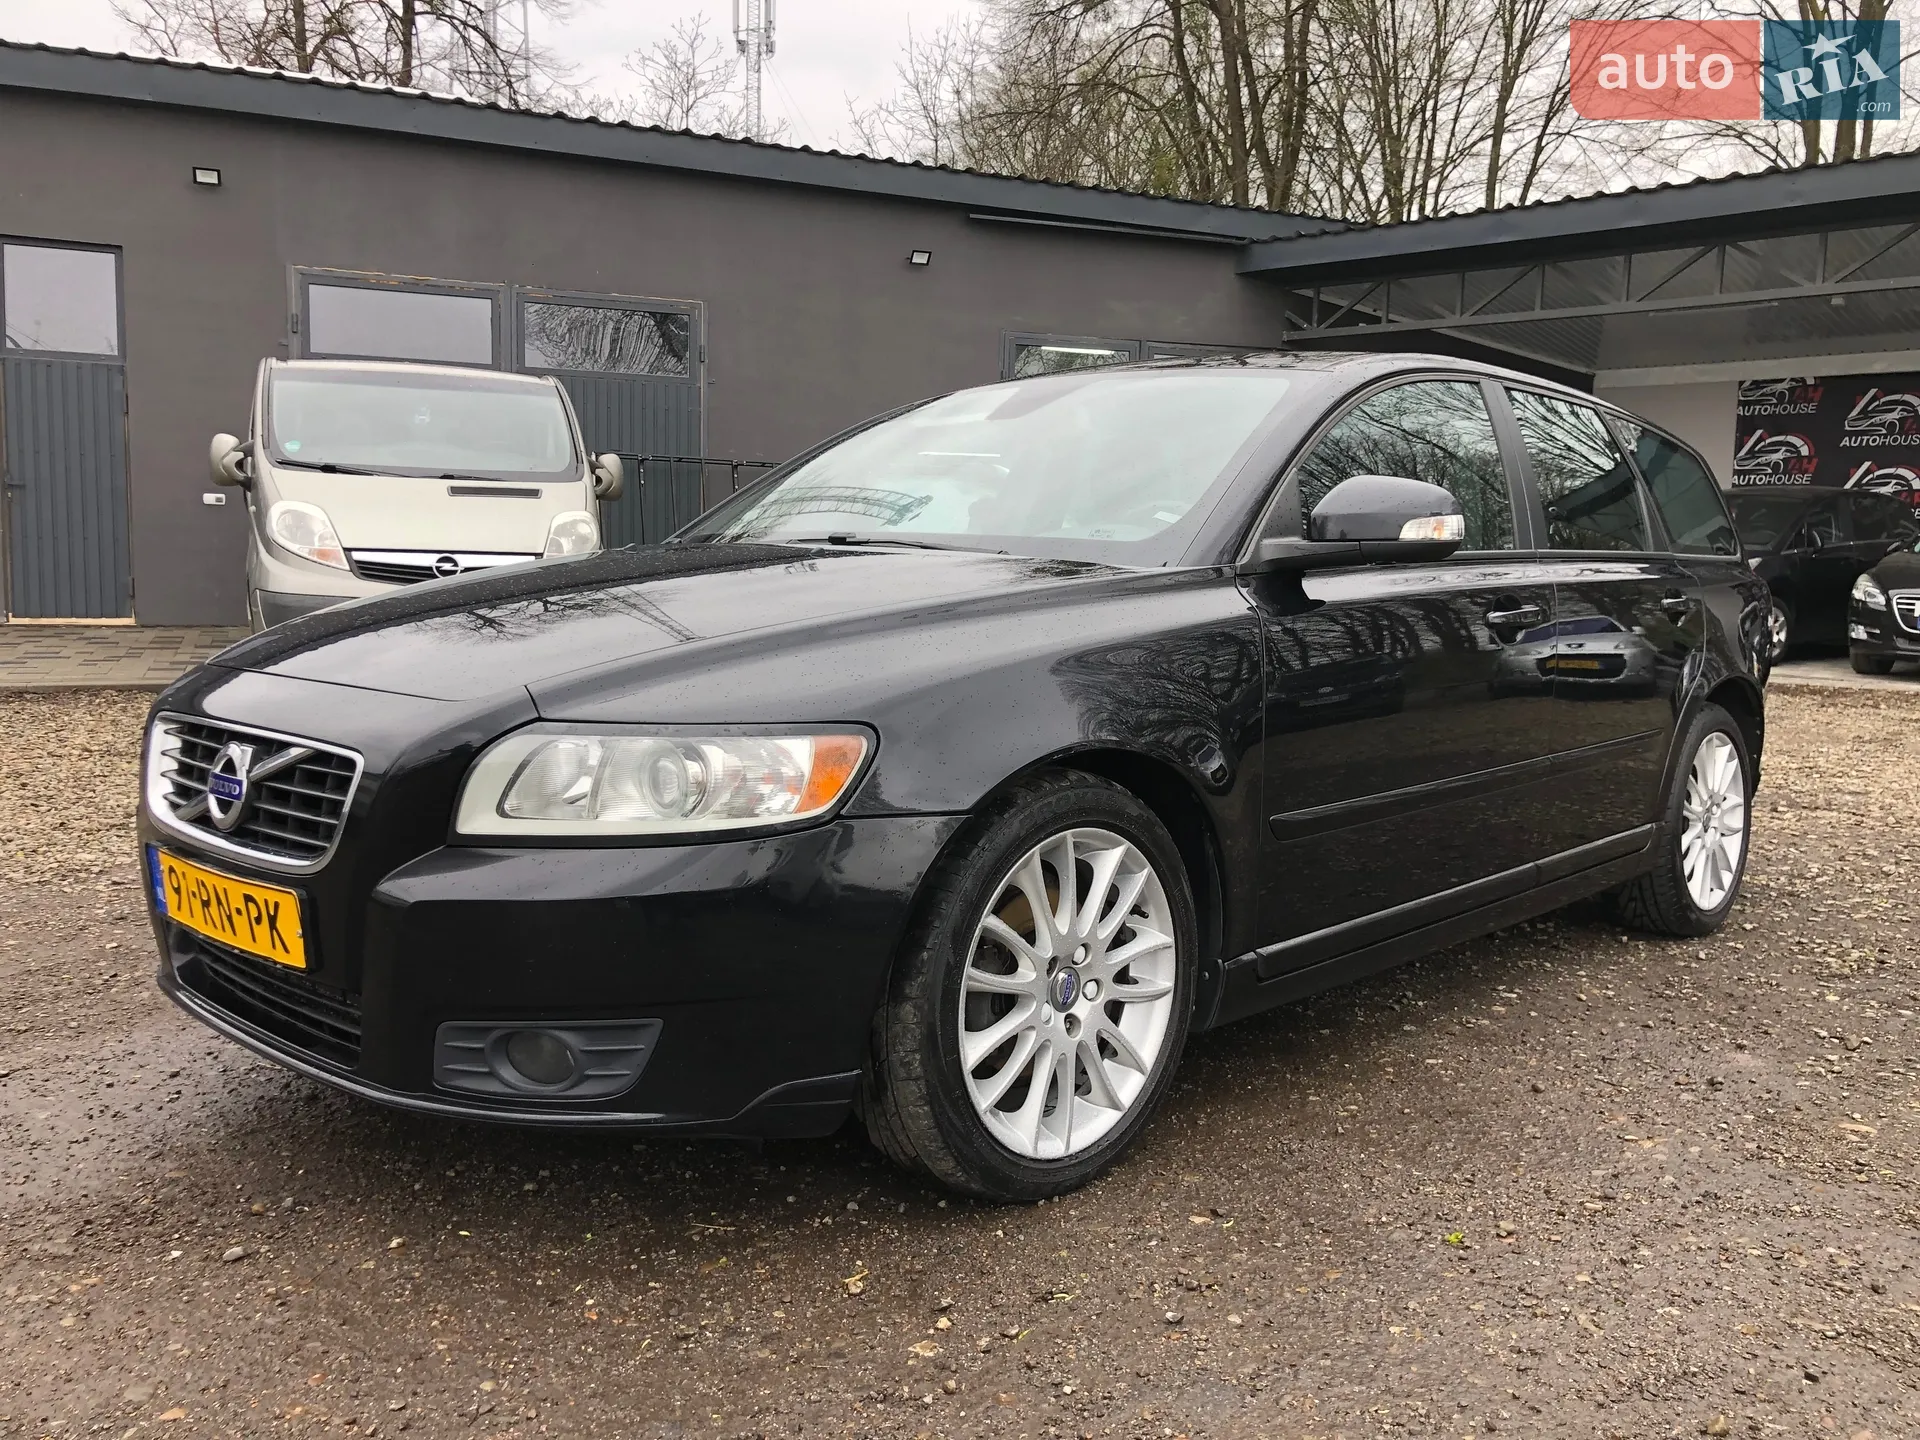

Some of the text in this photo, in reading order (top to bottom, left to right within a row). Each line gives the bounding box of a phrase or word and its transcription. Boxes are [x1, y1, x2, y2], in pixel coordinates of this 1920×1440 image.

[1737, 403, 1818, 416] AUTOHOUSE
[1839, 434, 1920, 447] AUTOHOUS
[1732, 474, 1812, 485] AUTOHOUSE
[168, 864, 291, 954] 91-RN-PK
